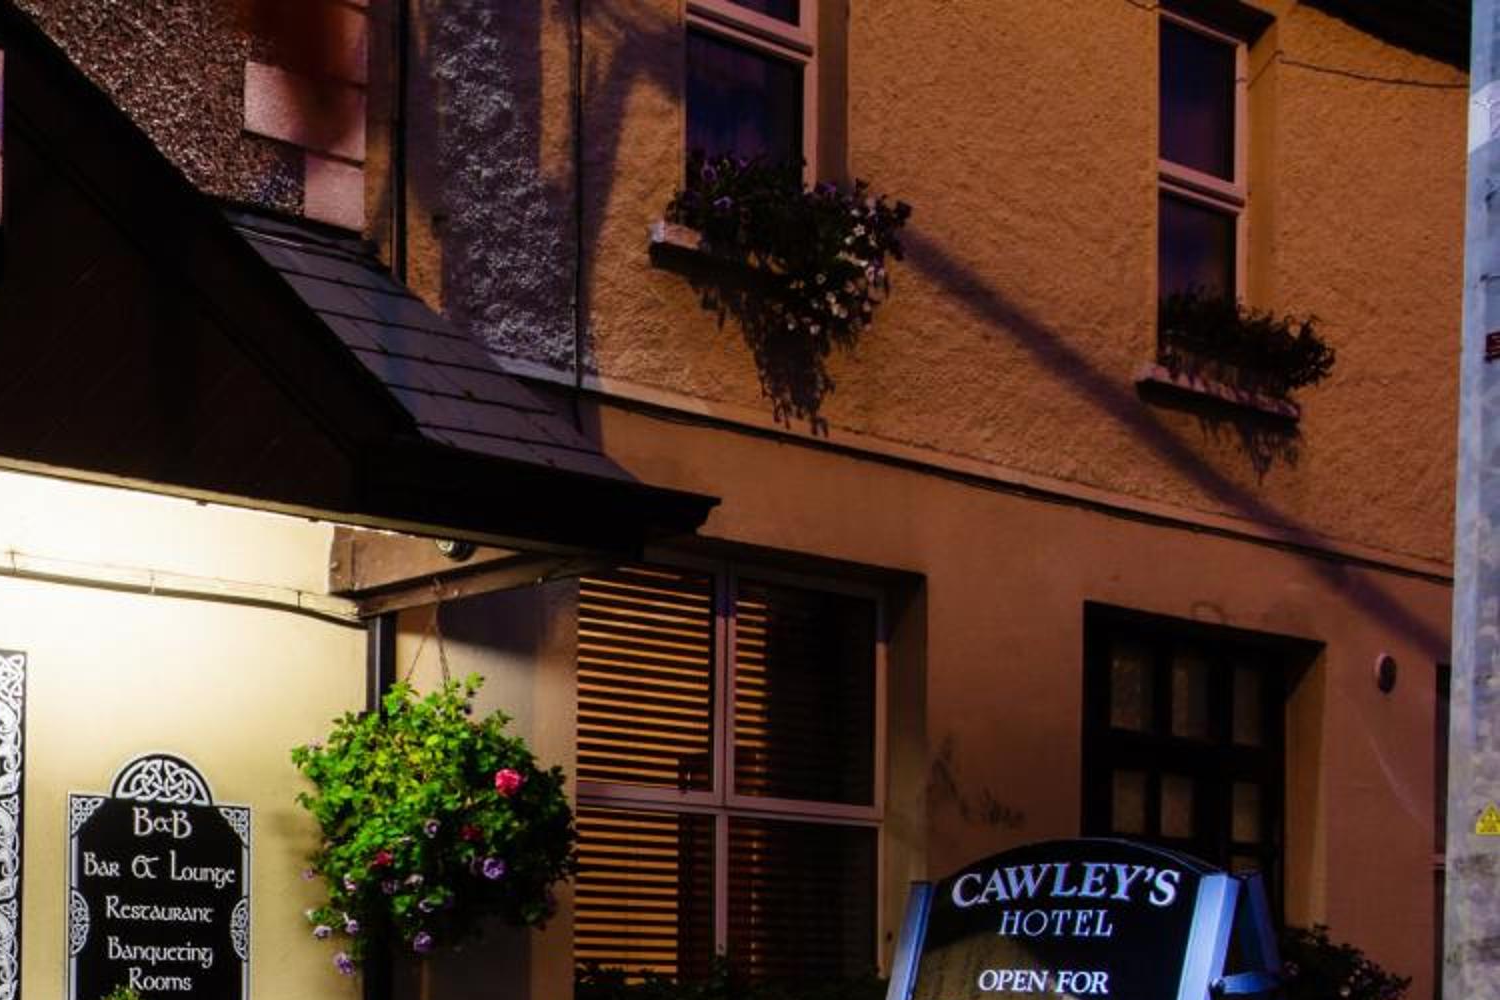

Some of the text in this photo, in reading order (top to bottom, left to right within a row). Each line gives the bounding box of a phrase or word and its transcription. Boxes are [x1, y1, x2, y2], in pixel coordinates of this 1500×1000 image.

[83, 850, 235, 888] Bar & Lounge
[951, 863, 1181, 908] CAWLEY'S
[105, 896, 214, 923] Restaurant
[997, 910, 1114, 938] HOTEL
[108, 936, 213, 968] Banqueting
[129, 967, 192, 991] Rooms
[978, 969, 1110, 995] OPEN FOR
